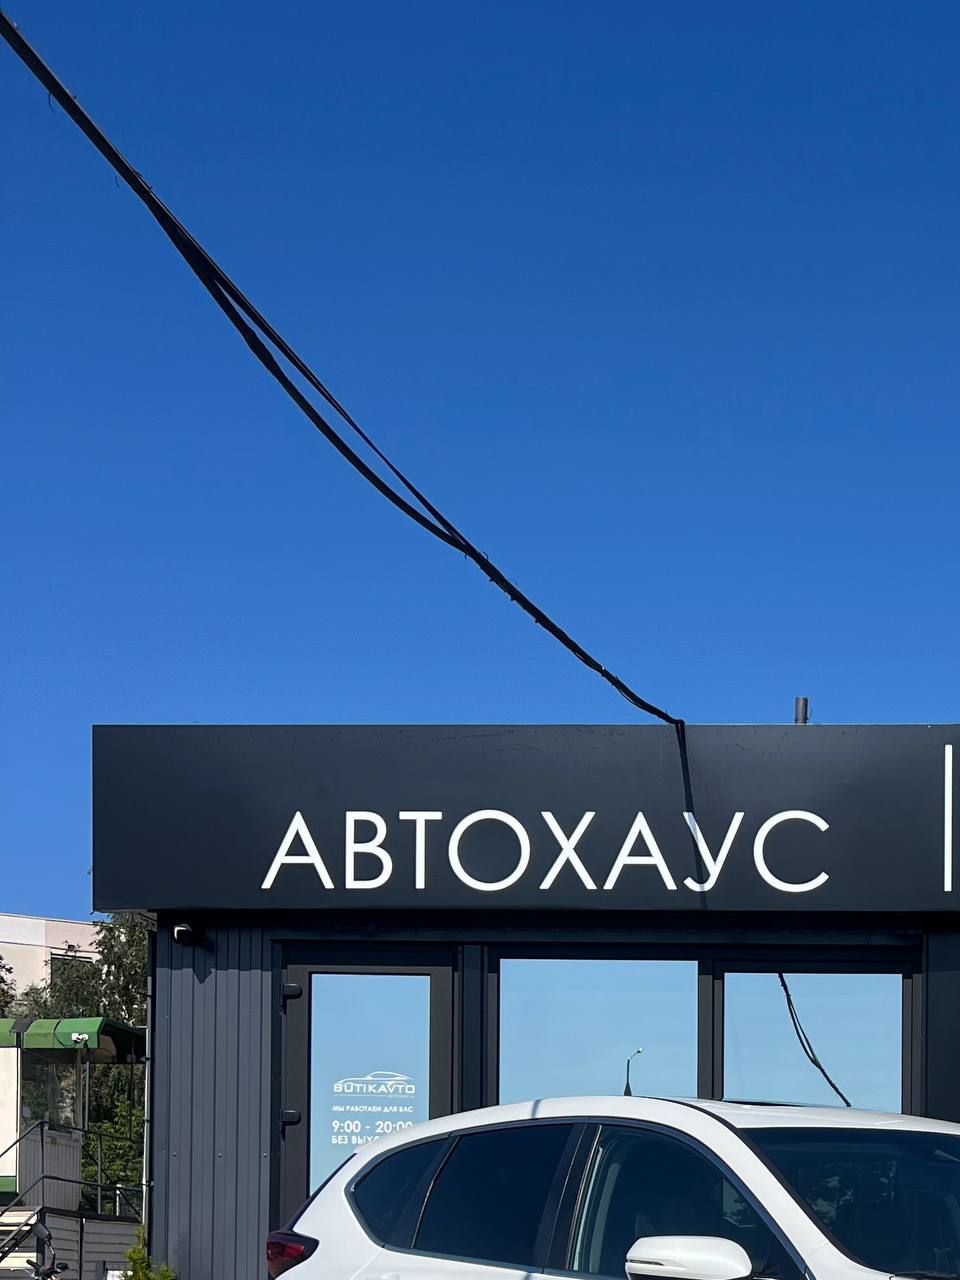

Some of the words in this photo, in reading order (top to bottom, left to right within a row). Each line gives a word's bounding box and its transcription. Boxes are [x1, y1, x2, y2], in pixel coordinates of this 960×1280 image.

[260, 809, 831, 893] АВТОХАУС
[333, 1083, 416, 1094] BUTIKAVTO
[332, 1120, 361, 1133] 9:00
[331, 1135, 348, 1144] БЕЗ
